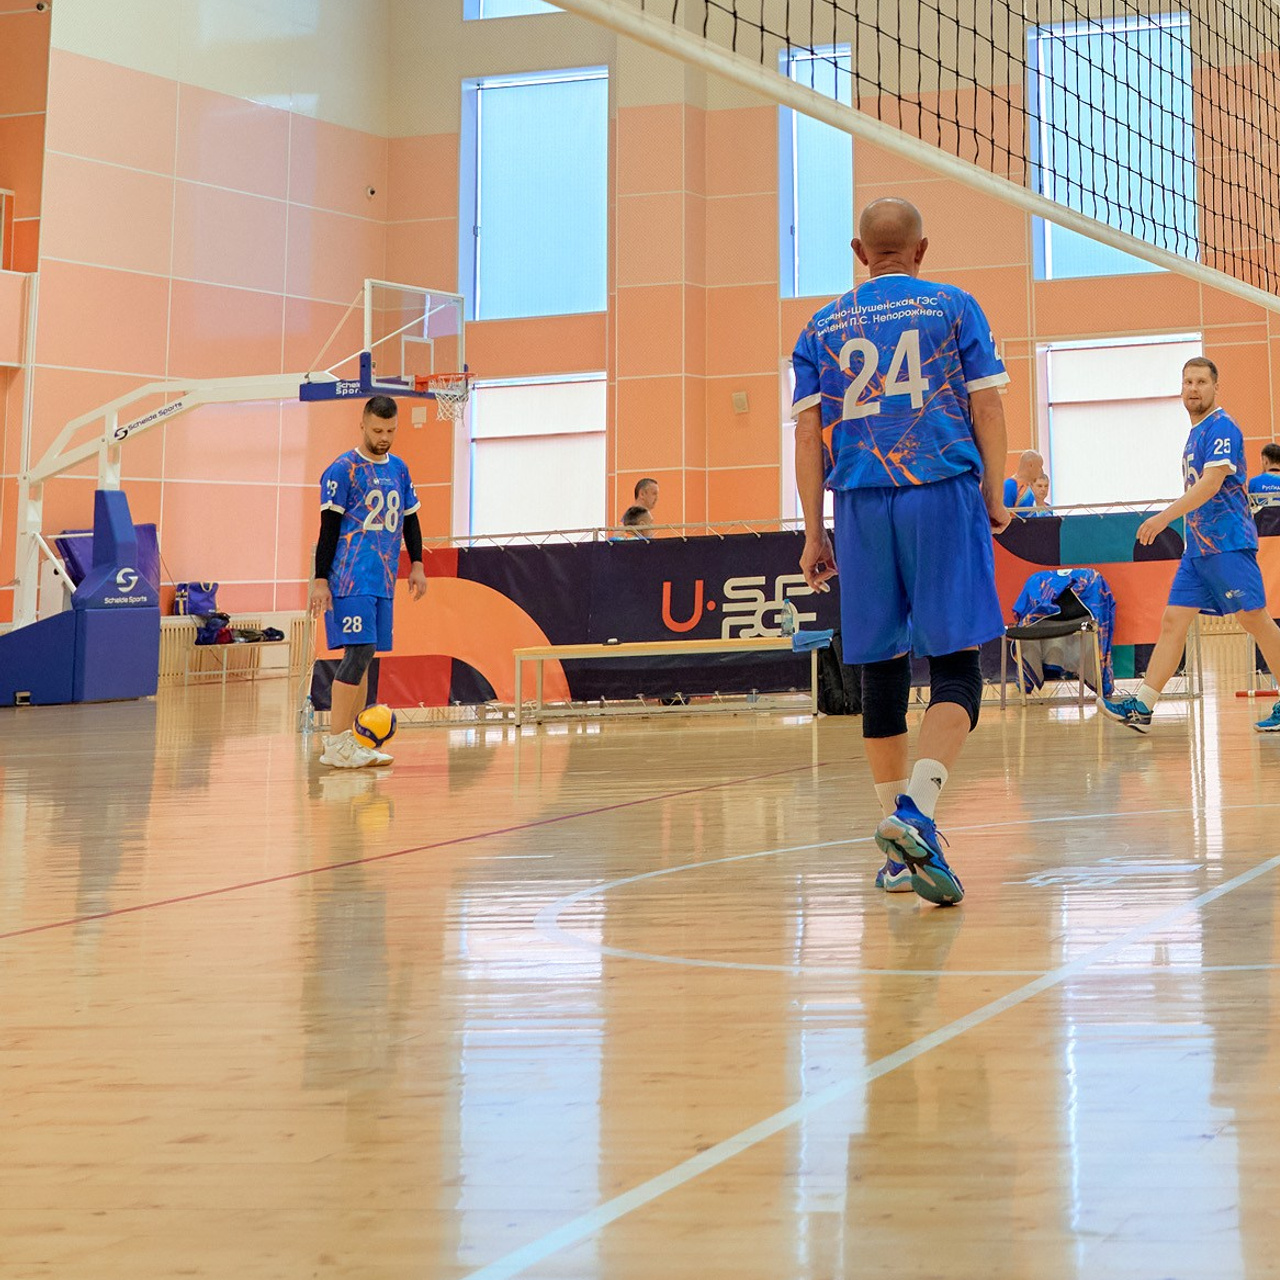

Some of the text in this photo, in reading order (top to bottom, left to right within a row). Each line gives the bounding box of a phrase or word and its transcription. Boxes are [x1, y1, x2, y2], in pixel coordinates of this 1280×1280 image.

[916, 296, 938, 306] ГЭС
[849, 316, 871, 327] П.С.
[872, 308, 944, 324] Непорожнего
[838, 328, 930, 420] 24
[335, 388, 362, 396] Spor
[157, 401, 183, 417] Sports
[1213, 438, 1231, 455] 25
[363, 489, 400, 533] 28
[342, 616, 363, 633] 28
